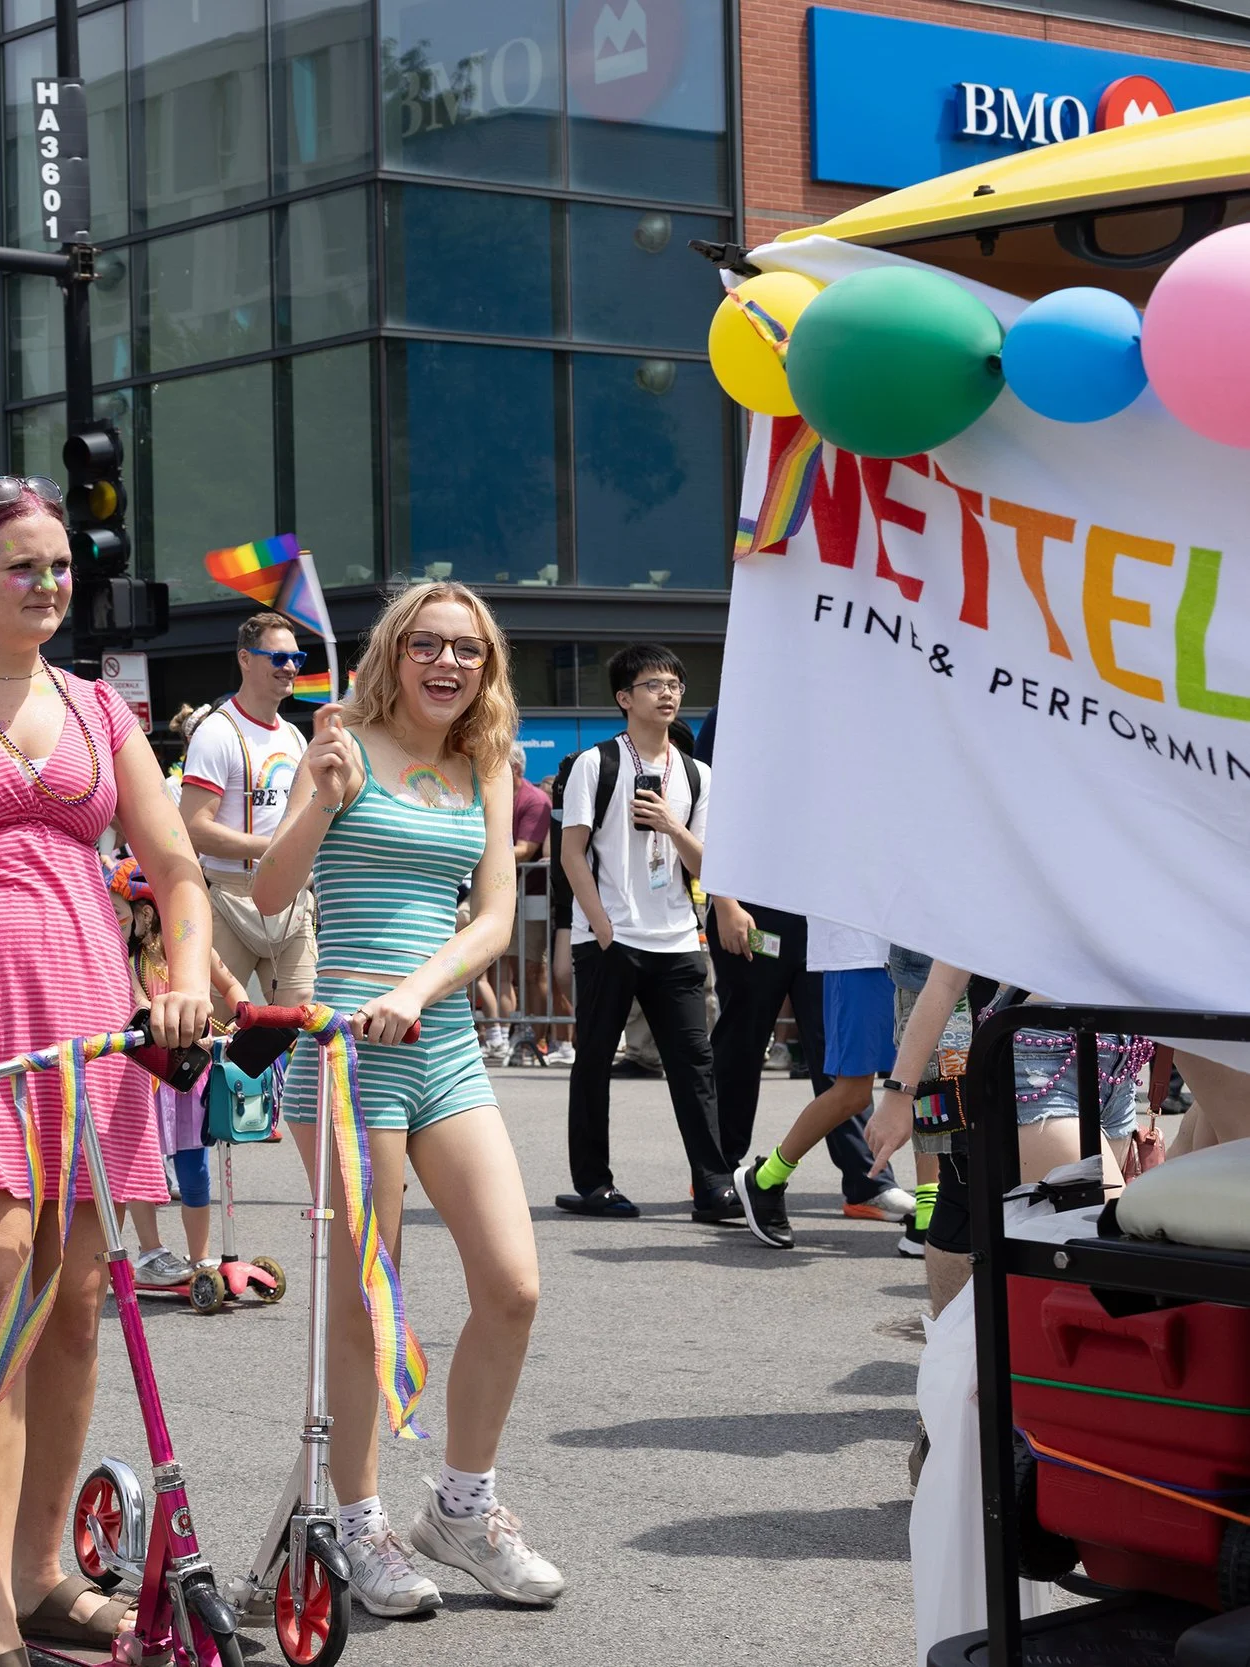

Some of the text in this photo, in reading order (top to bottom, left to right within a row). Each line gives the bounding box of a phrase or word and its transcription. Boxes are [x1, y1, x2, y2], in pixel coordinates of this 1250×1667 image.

[961, 82, 1089, 144] BMO
[36, 82, 61, 239] HA3601
[928, 644, 954, 678] &
